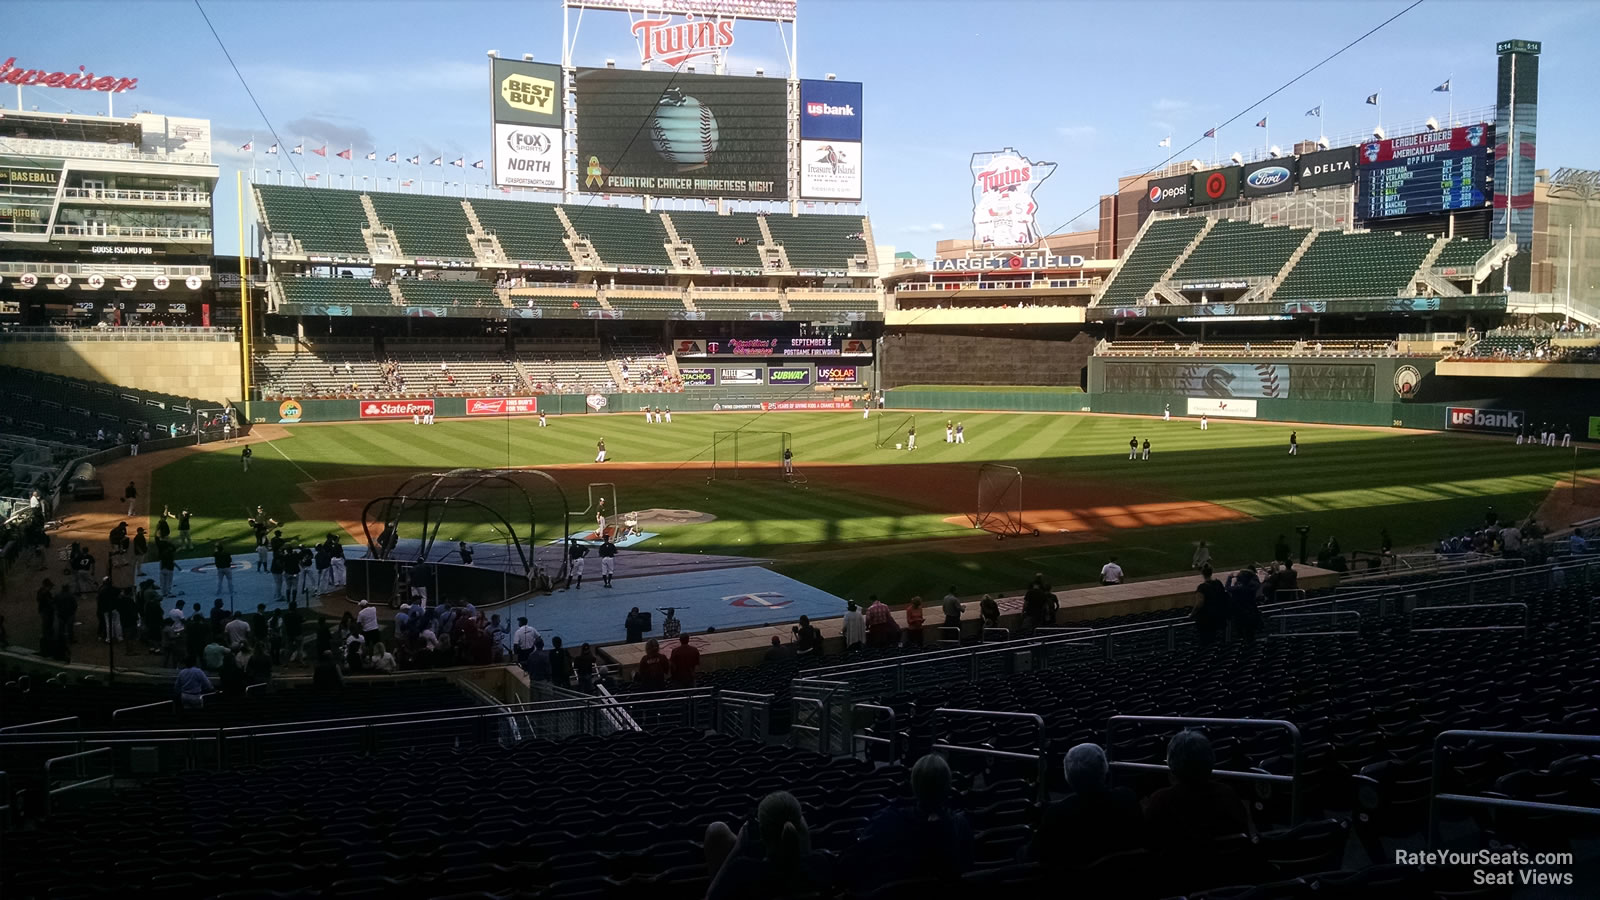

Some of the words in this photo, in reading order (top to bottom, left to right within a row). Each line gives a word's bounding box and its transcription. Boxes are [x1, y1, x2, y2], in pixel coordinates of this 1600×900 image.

[632, 14, 734, 62] Twins
[508, 79, 553, 98] BEST
[509, 91, 548, 108] BUY
[516, 132, 541, 147] FOX
[1391, 136, 1418, 149] LEAGUE
[1419, 130, 1452, 144] LEADERS
[516, 145, 543, 153] SPORTS
[1392, 145, 1425, 160] AMERICAN
[1426, 142, 1451, 154] LEAGUE
[507, 157, 551, 173] NORTH
[807, 163, 832, 174] Treasure
[837, 164, 856, 175] Island
[1314, 160, 1351, 175] DELTA
[1386, 166, 1407, 174] ESTRADA
[11, 171, 57, 183] BASEBALL
[977, 166, 1031, 194] Twins
[1255, 171, 1281, 186] Ford
[1386, 171, 1413, 181] VERLANDER
[608, 176, 655, 188] PEDIATRIC
[657, 177, 692, 190] CANCER
[694, 179, 746, 192] AWARENESS
[748, 181, 774, 193] NIGHT
[1162, 184, 1187, 200] pepsi
[1385, 200, 1407, 209] SANCHEZ
[1385, 207, 1408, 216] KENNEDY
[92, 246, 114, 254] GOOSE
[114, 246, 138, 254] ISLAND
[138, 247, 153, 255] PUB
[934, 257, 1007, 271] TARGET
[1026, 255, 1085, 268] FIELD
[791, 339, 826, 347] SEPTEMBER
[827, 339, 832, 347] 2
[681, 373, 711, 381] STACHIOS
[770, 371, 808, 380] SUBWAY
[595, 398, 606, 406] 29
[767, 402, 777, 410] 25
[1452, 409, 1519, 428] usbank
